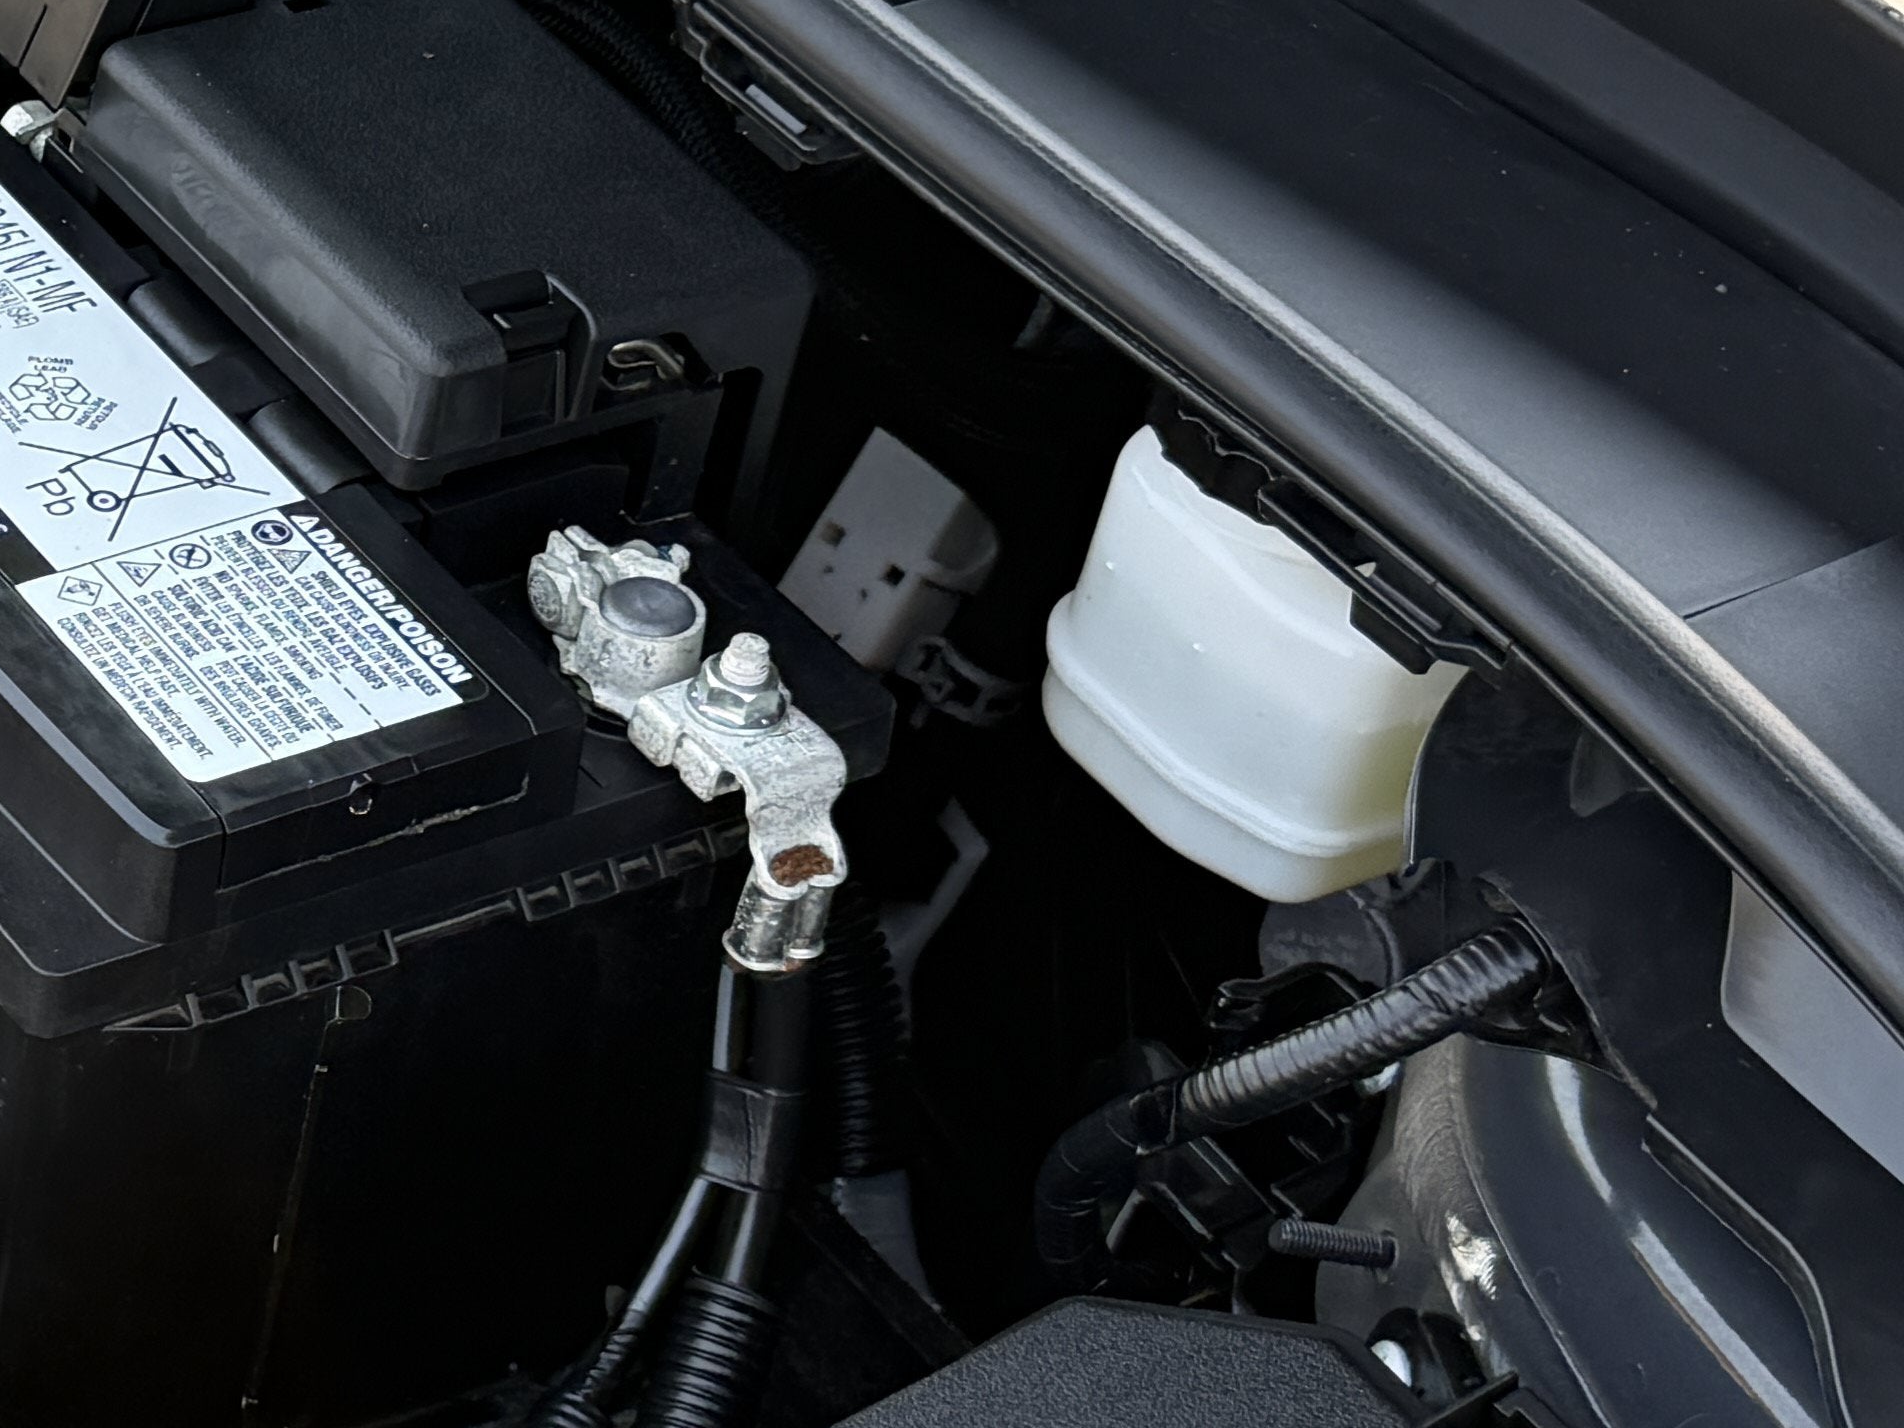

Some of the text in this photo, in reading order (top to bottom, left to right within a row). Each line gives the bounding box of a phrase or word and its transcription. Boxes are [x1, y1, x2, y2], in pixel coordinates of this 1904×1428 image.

[25, 477, 77, 517] Pb
[133, 595, 152, 607] OR
[144, 606, 176, 633] SEVERE
[167, 584, 237, 652] SULFURIC ACID CAN
[214, 570, 233, 583] NO
[283, 645, 323, 679] SMOKING
[266, 571, 289, 587] LES
[304, 611, 329, 627] LES
[320, 627, 345, 645] GAZ
[336, 645, 387, 689] EXPLOSIFS
[270, 598, 289, 609] OU
[294, 576, 315, 591] CAN
[309, 591, 338, 613] CAUSE
[368, 651, 386, 663] OR
[309, 529, 470, 682] DANGER/POISON
[311, 571, 441, 696] SHIELD EYES. EXPLOSIVE GASES
[57, 617, 101, 658] CONSULTEZ
[92, 657, 110, 669] UN
[91, 607, 113, 622] GET
[106, 622, 141, 655] MEDICAL
[135, 655, 162, 674] HELP
[96, 637, 117, 652] LES
[110, 652, 135, 672] YEUX
[108, 602, 139, 627] FLUSH
[131, 626, 157, 646] EYES
[149, 646, 202, 695] IMMEDIATELY
[194, 695, 221, 717] WITH
[199, 665, 221, 681] DES
[262, 685, 315, 733] SULFURIQUE
